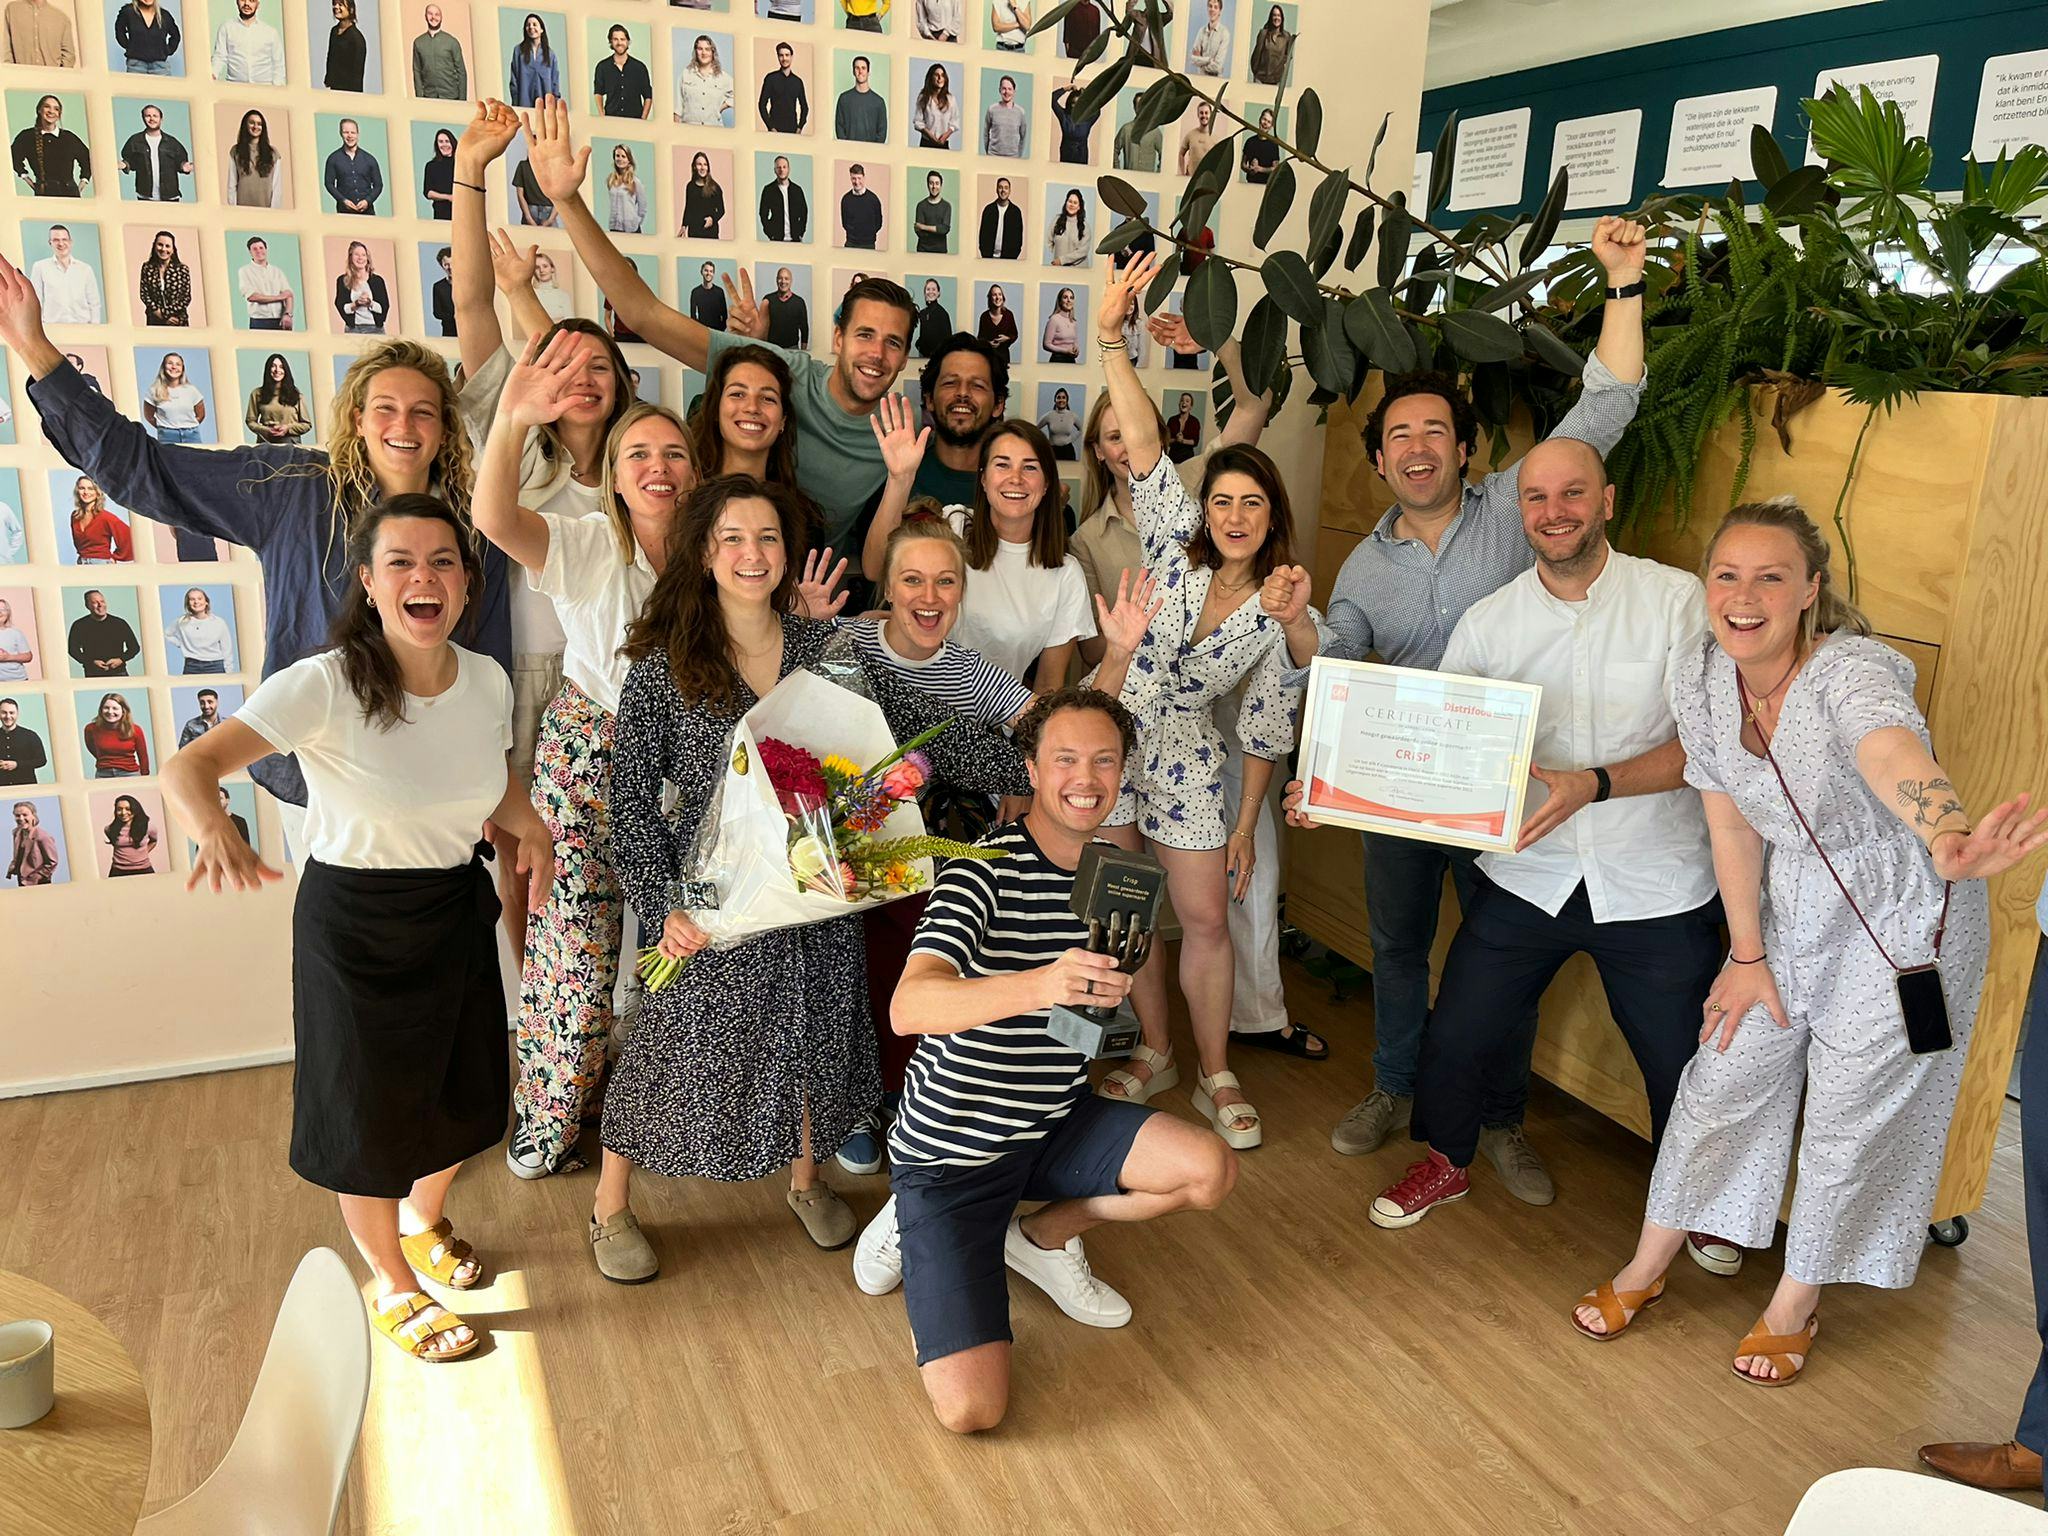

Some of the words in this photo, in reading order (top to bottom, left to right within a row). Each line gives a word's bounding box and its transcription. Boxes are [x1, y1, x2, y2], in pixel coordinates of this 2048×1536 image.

[2008, 71, 2032, 80] kwam
[2034, 70, 2043, 78] er
[1870, 79, 1886, 88] fijne
[1886, 76, 1915, 86] ervaring
[1997, 86, 2010, 95] dat
[2012, 85, 2019, 93] ik
[1995, 99, 2014, 108] klant
[2016, 96, 2034, 106] ben!
[2037, 95, 2047, 103] En
[1713, 109, 1723, 118] zijn
[1724, 108, 1732, 116] de
[1733, 104, 1760, 114] lekkerste
[1993, 108, 2037, 121] ontzettend
[1716, 130, 1724, 138] En
[1683, 142, 1720, 152] schuldgevoel
[1365, 706, 1472, 731] CERTIFICATE
[1396, 748, 1431, 762] CRISP
[1123, 876, 1139, 885] Crisp
[1122, 892, 1146, 901] supermarkt
